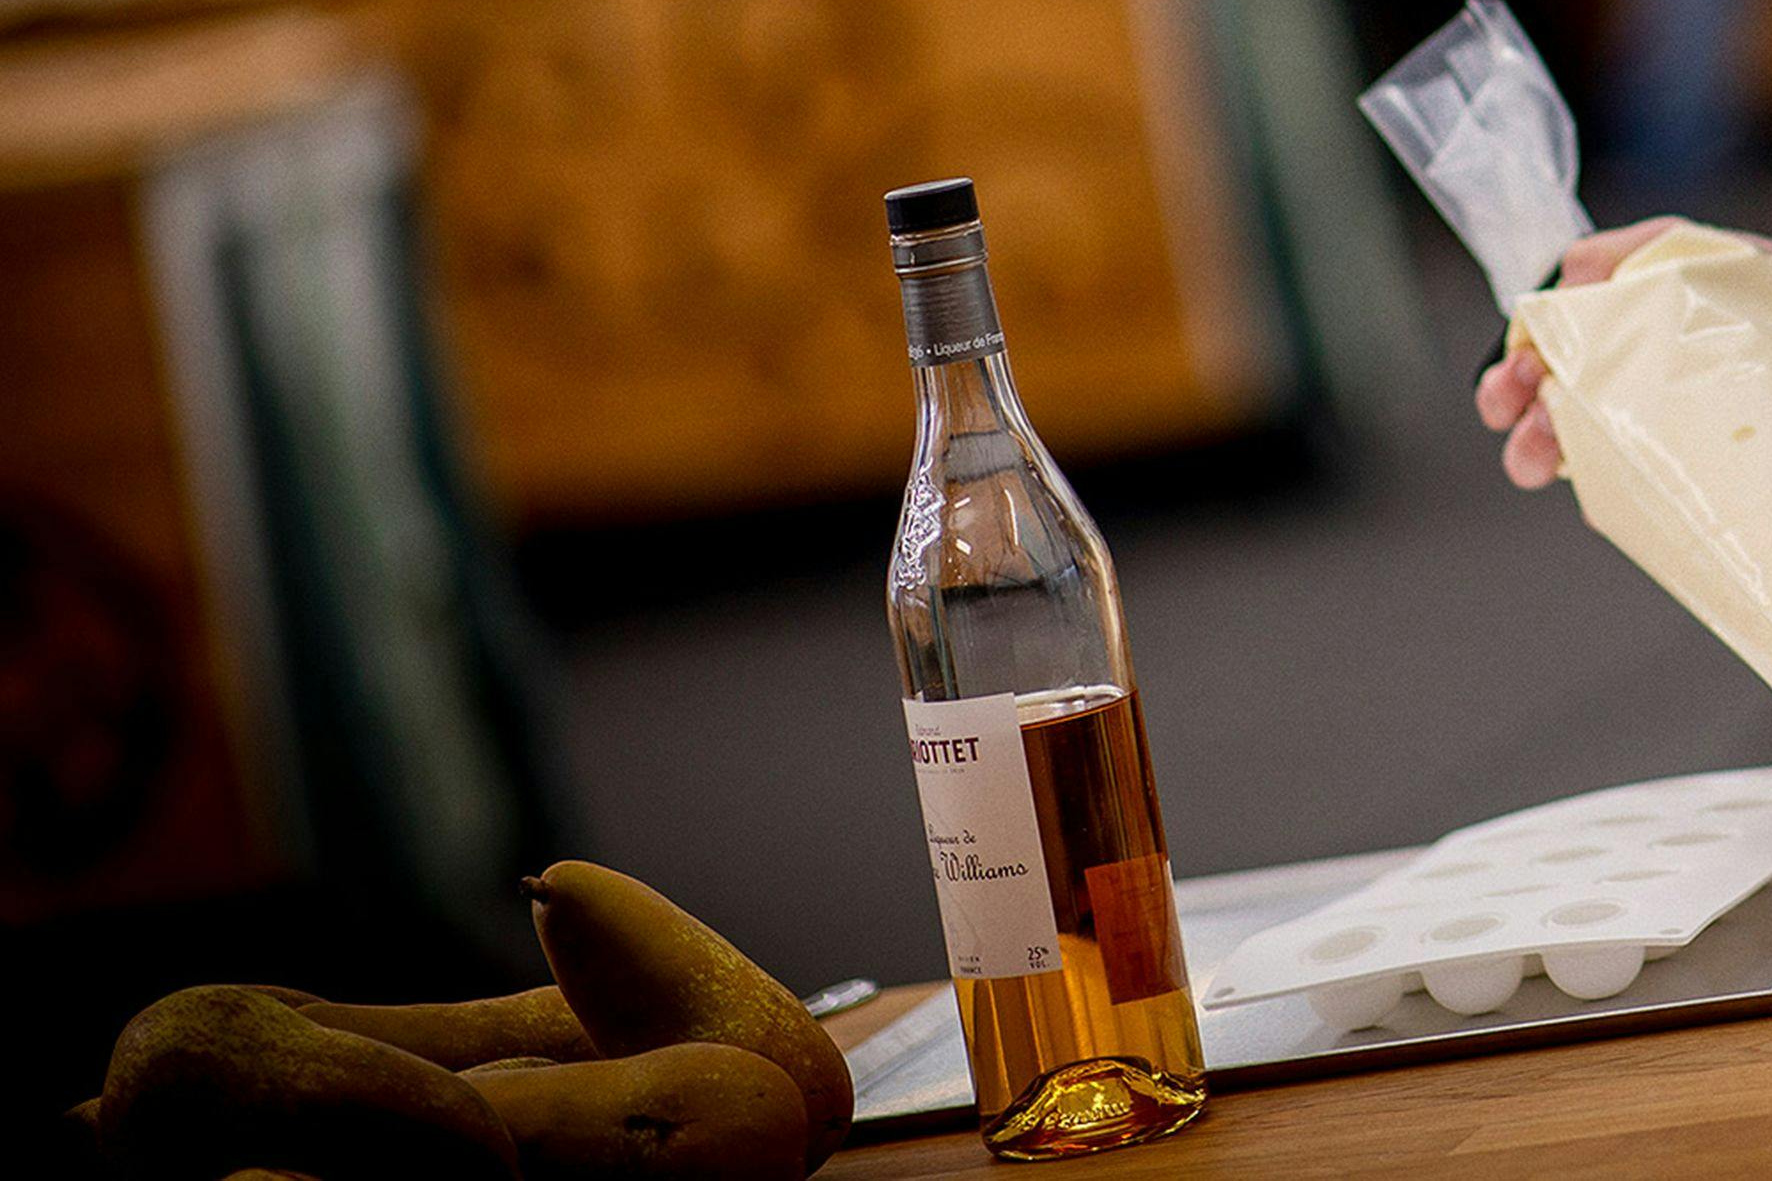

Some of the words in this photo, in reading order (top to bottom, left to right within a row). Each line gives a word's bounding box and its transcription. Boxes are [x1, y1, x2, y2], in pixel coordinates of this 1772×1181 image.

[933, 340, 972, 357] Liqueur
[972, 336, 986, 349] de
[963, 829, 977, 844] de
[940, 851, 1029, 882] Williams
